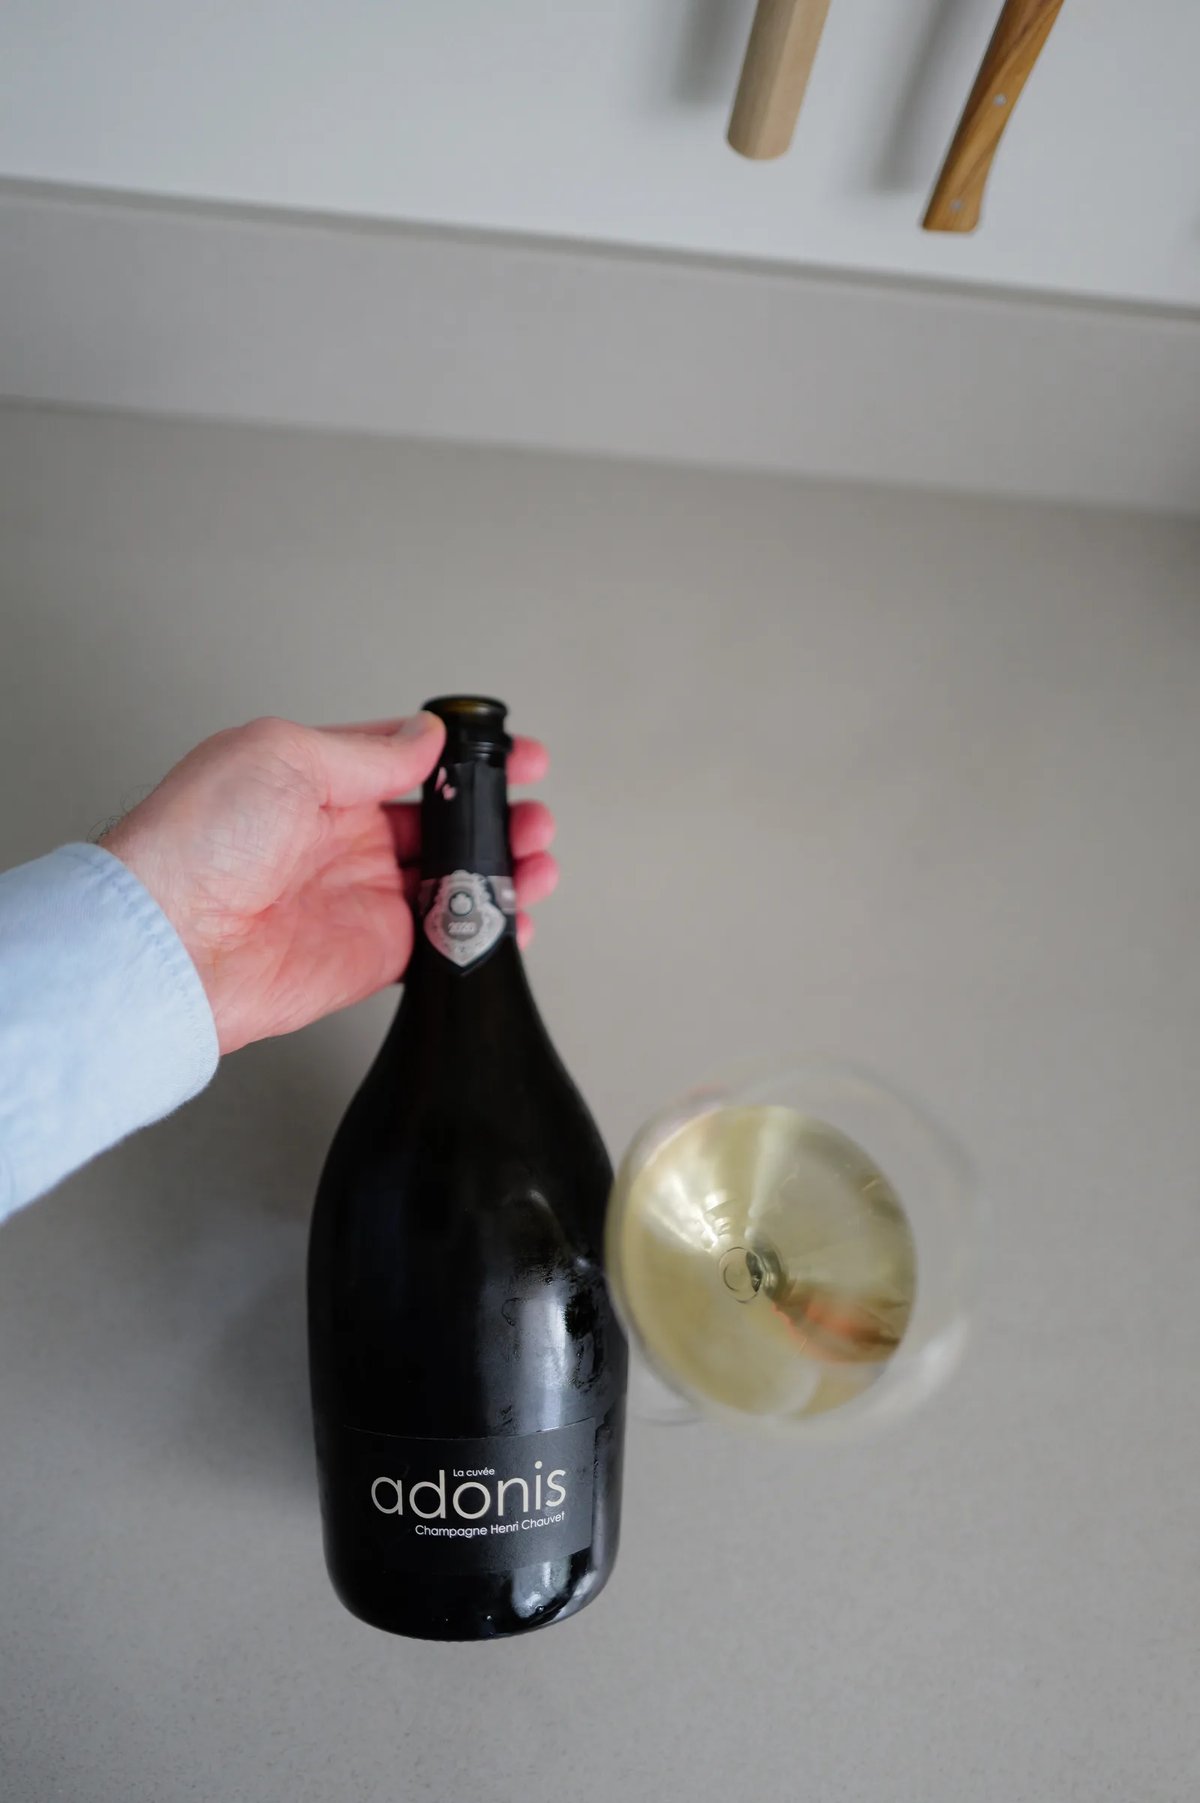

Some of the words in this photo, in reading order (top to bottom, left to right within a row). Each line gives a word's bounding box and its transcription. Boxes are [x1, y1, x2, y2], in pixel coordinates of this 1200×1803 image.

[453, 1468, 464, 1477] La
[466, 1467, 495, 1477] cuvée
[371, 1460, 566, 1519] adonis
[415, 1524, 487, 1538] Champagne
[490, 1521, 519, 1534] Henri
[521, 1511, 565, 1530] Chauvet
